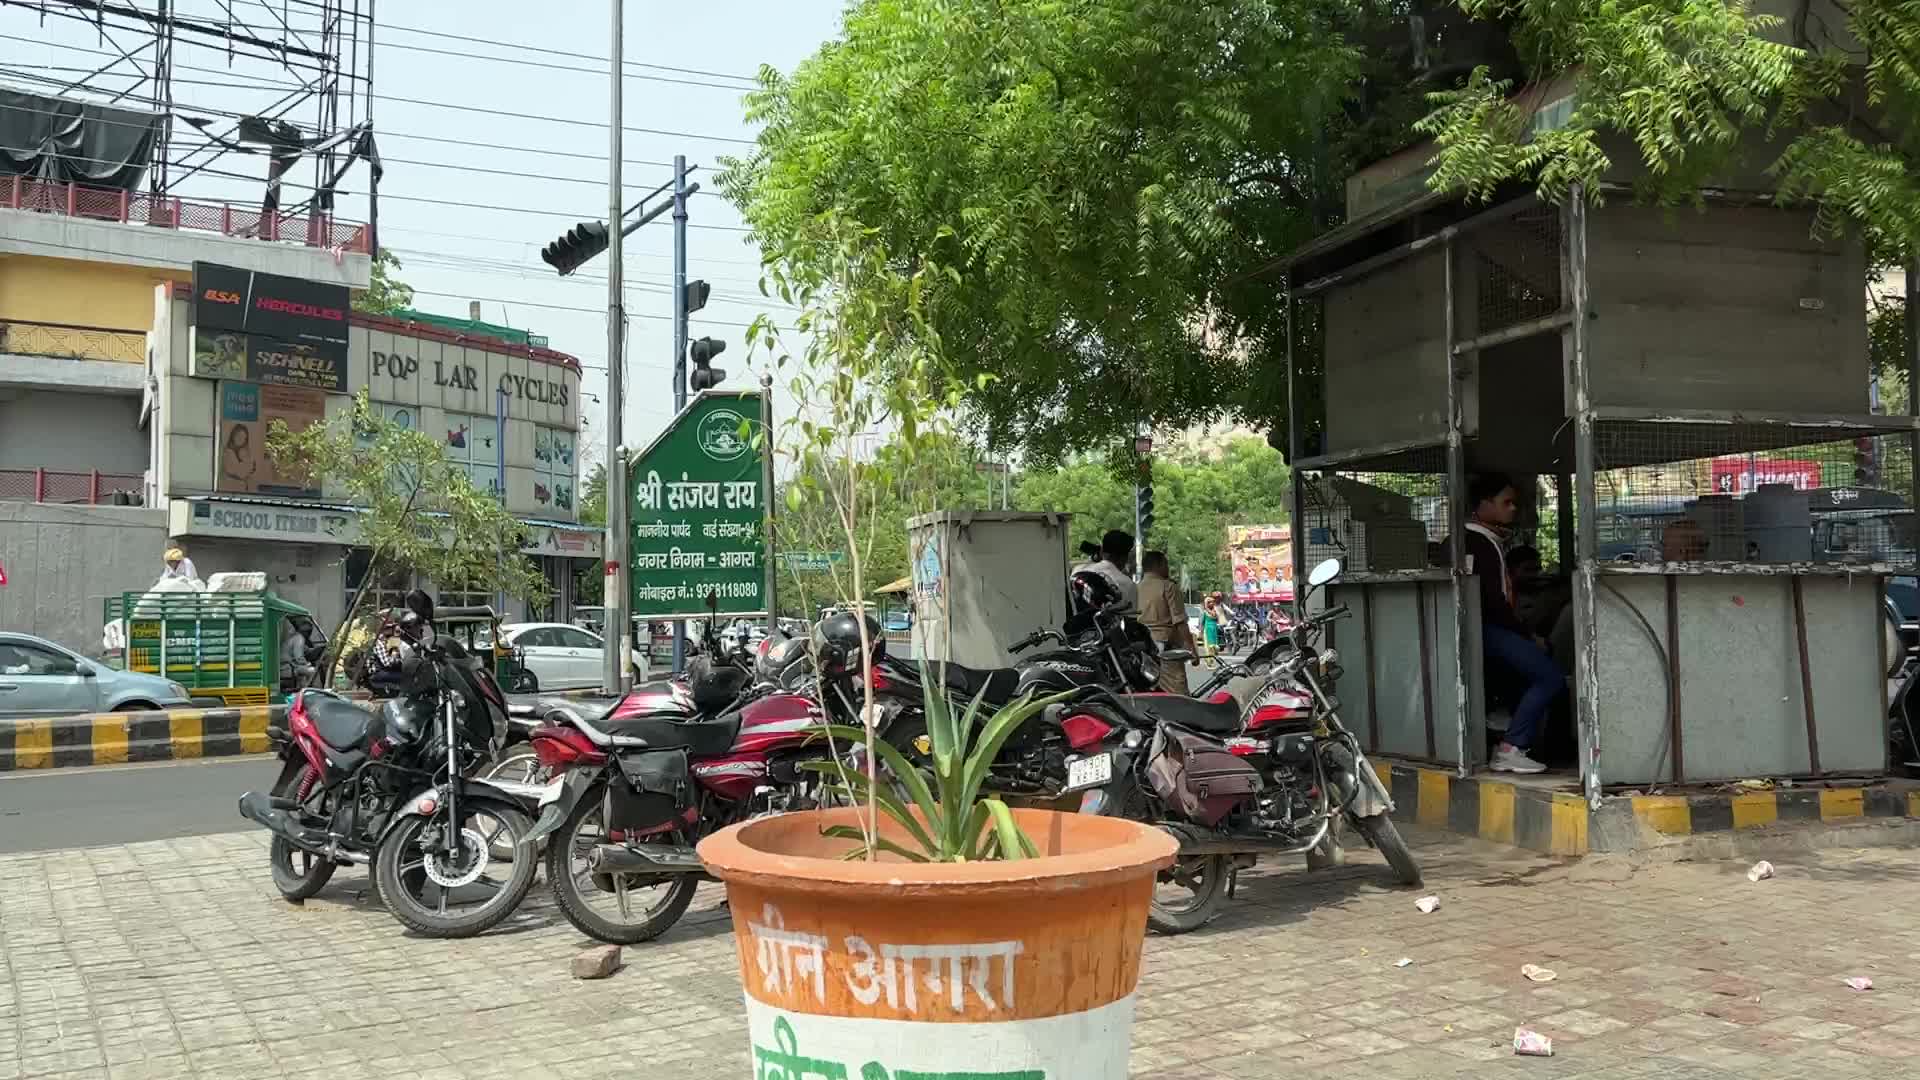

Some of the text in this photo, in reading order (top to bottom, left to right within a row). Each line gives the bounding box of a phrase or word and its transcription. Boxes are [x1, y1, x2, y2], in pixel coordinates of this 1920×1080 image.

[204, 288, 241, 304] BSA
[255, 297, 343, 321] HERCULES
[372, 351, 419, 380] POP
[433, 360, 478, 392] LAR
[499, 372, 569, 407] CYCLES
[637, 470, 757, 511] श्री संजय राय
[213, 510, 272, 530] SCHOOL
[638, 553, 669, 569] नगर
[670, 546, 705, 569] निगम
[719, 551, 756, 569] आगरा
[639, 582, 676, 601] मोबाइल
[844, 935, 1025, 1014] आगरा
